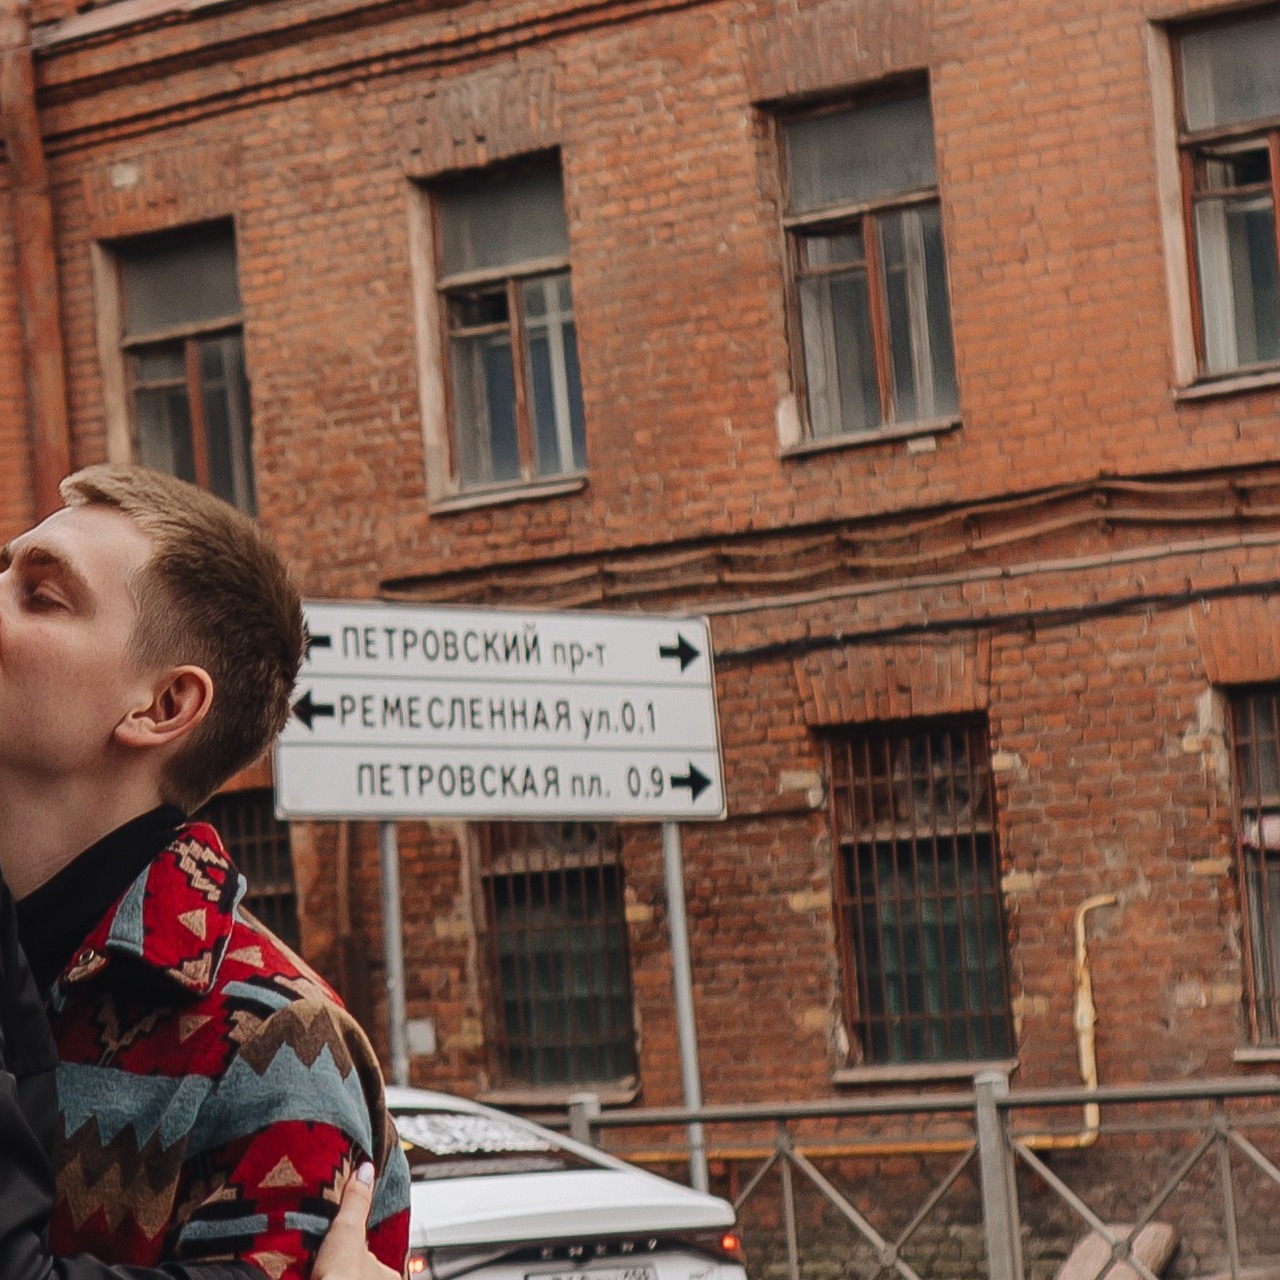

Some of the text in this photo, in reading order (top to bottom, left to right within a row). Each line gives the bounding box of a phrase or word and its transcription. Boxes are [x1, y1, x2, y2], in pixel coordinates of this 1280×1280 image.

[341, 623, 606, 671] ПЕТРОВСКИЙ пр-т
[340, 694, 572, 733] РЕМЕСЛЕННАЯ
[357, 763, 560, 798] ПЕТРОВСКАЯ
[571, 774, 611, 798] пл.
